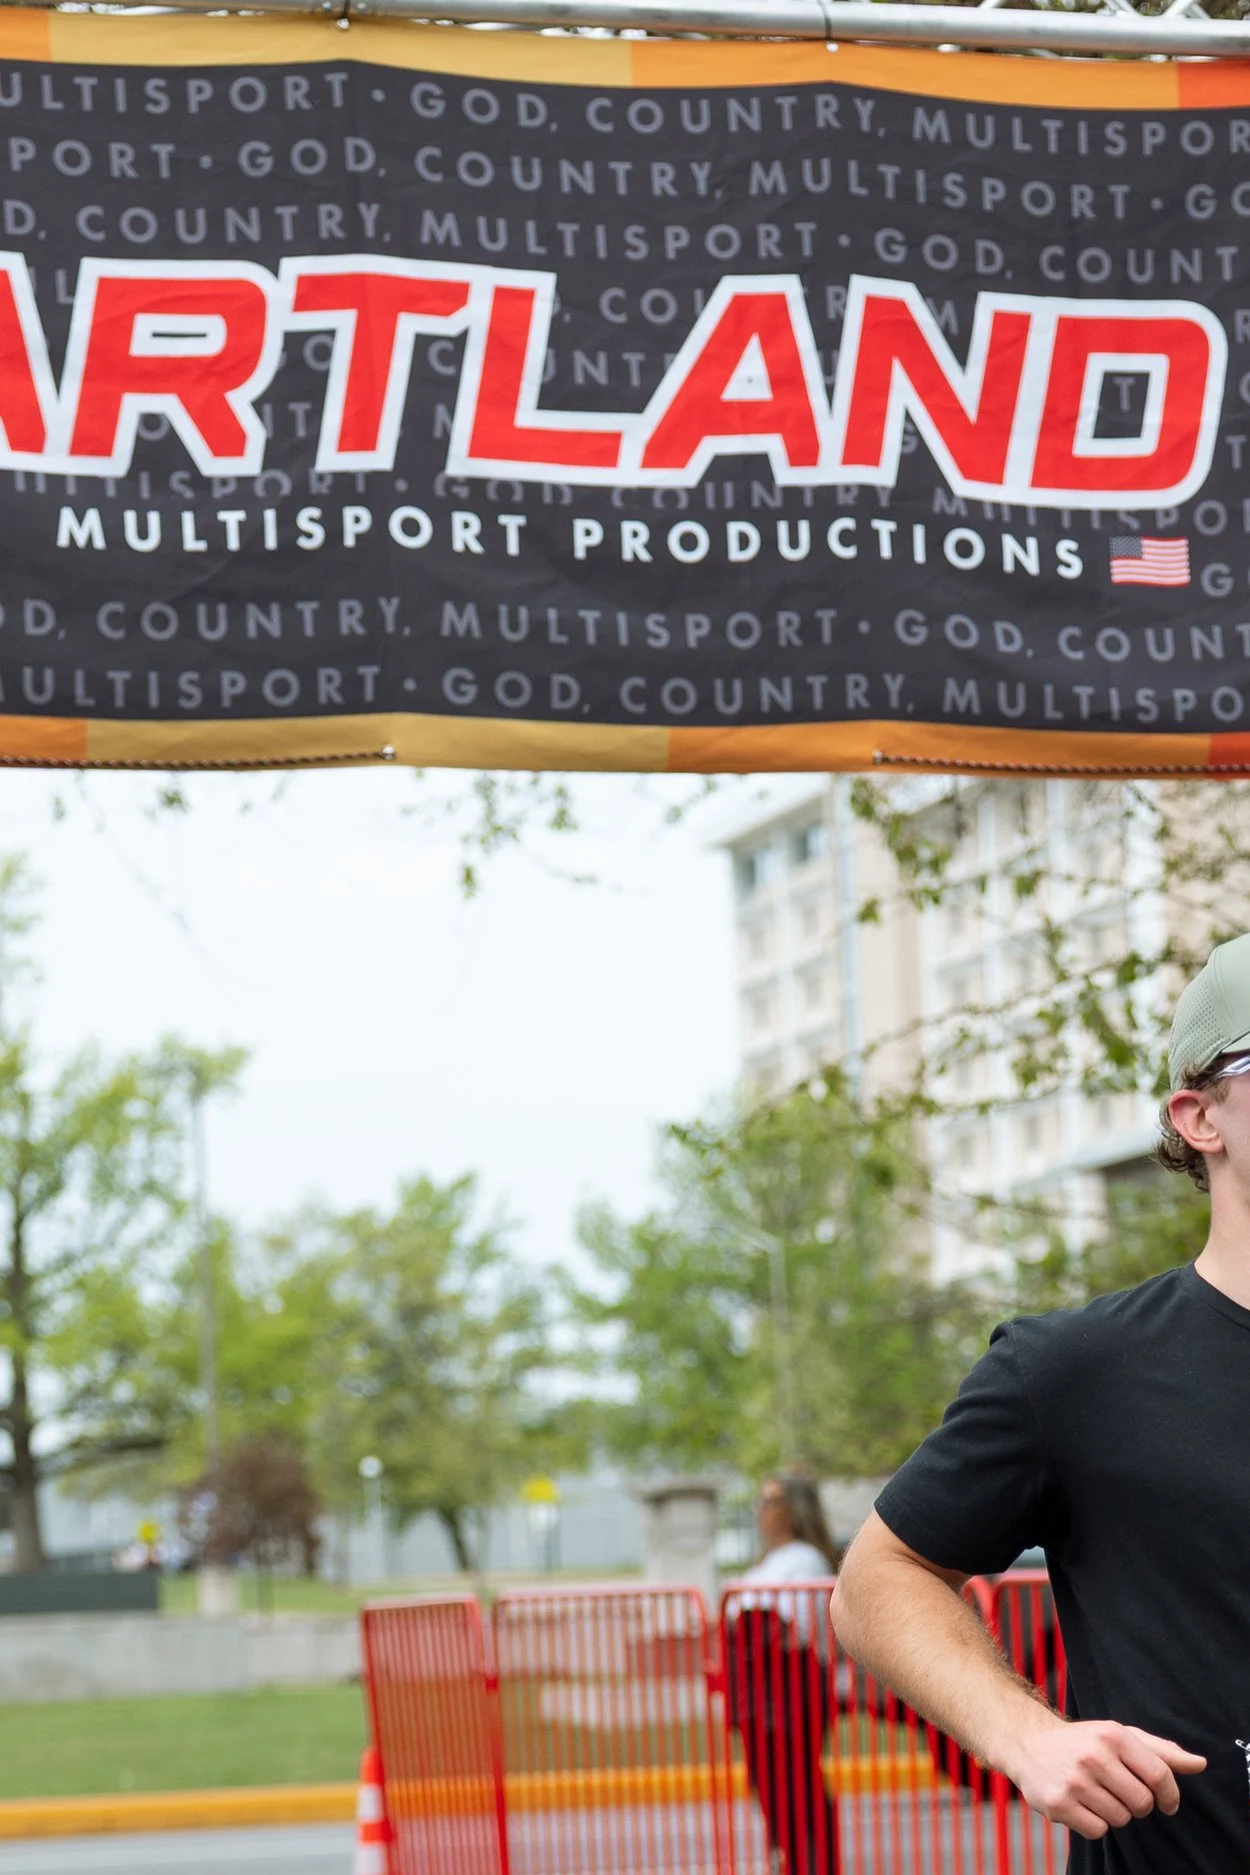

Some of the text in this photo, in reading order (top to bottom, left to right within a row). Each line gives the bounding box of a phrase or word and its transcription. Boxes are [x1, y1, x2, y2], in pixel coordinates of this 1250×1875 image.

[748, 158, 1130, 218] MULTISPORT
[421, 209, 816, 260] MULTISPORT
[57, 506, 1083, 580] MULTISPORT PRODUCTIONS
[0, 599, 64, 638] D,
[442, 602, 836, 649] MULTISPORT
[0, 666, 379, 707] ULTISPORT
